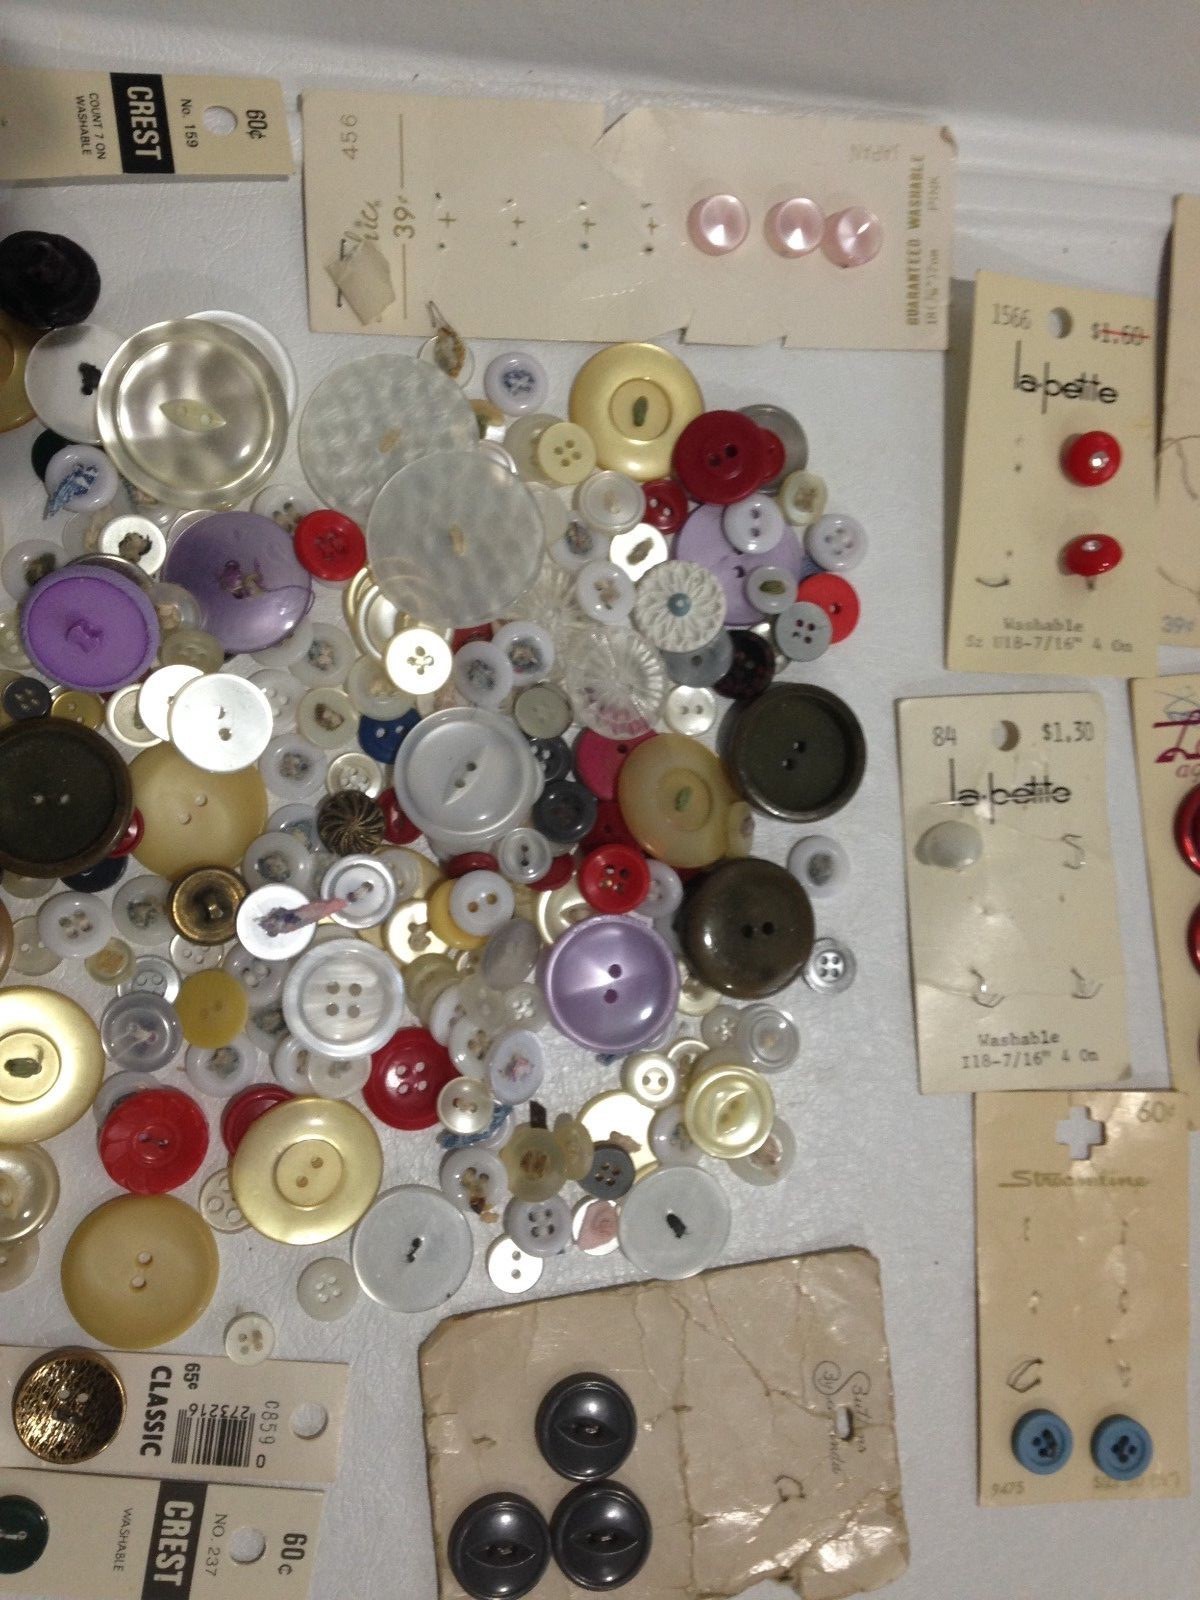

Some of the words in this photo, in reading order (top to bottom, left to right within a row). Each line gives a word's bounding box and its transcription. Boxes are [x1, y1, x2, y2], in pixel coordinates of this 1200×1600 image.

[126, 86, 162, 161] CREST
[181, 98, 192, 118] No.
[75, 95, 92, 156] WASHABLE
[89, 92, 103, 130] COUNT
[96, 142, 106, 160] ON
[184, 124, 199, 148] 159
[340, 113, 358, 160] 456
[992, 303, 1032, 330] 1566
[932, 726, 957, 747] 84
[1042, 721, 1096, 743] $1.30
[978, 1030, 1060, 1048] Washable
[140, 1365, 172, 1458] CLASSIC
[188, 1403, 250, 1420] 273216
[112, 1507, 134, 1573] WASHABLE
[153, 1500, 194, 1587] CREST
[205, 1546, 221, 1578] 237
